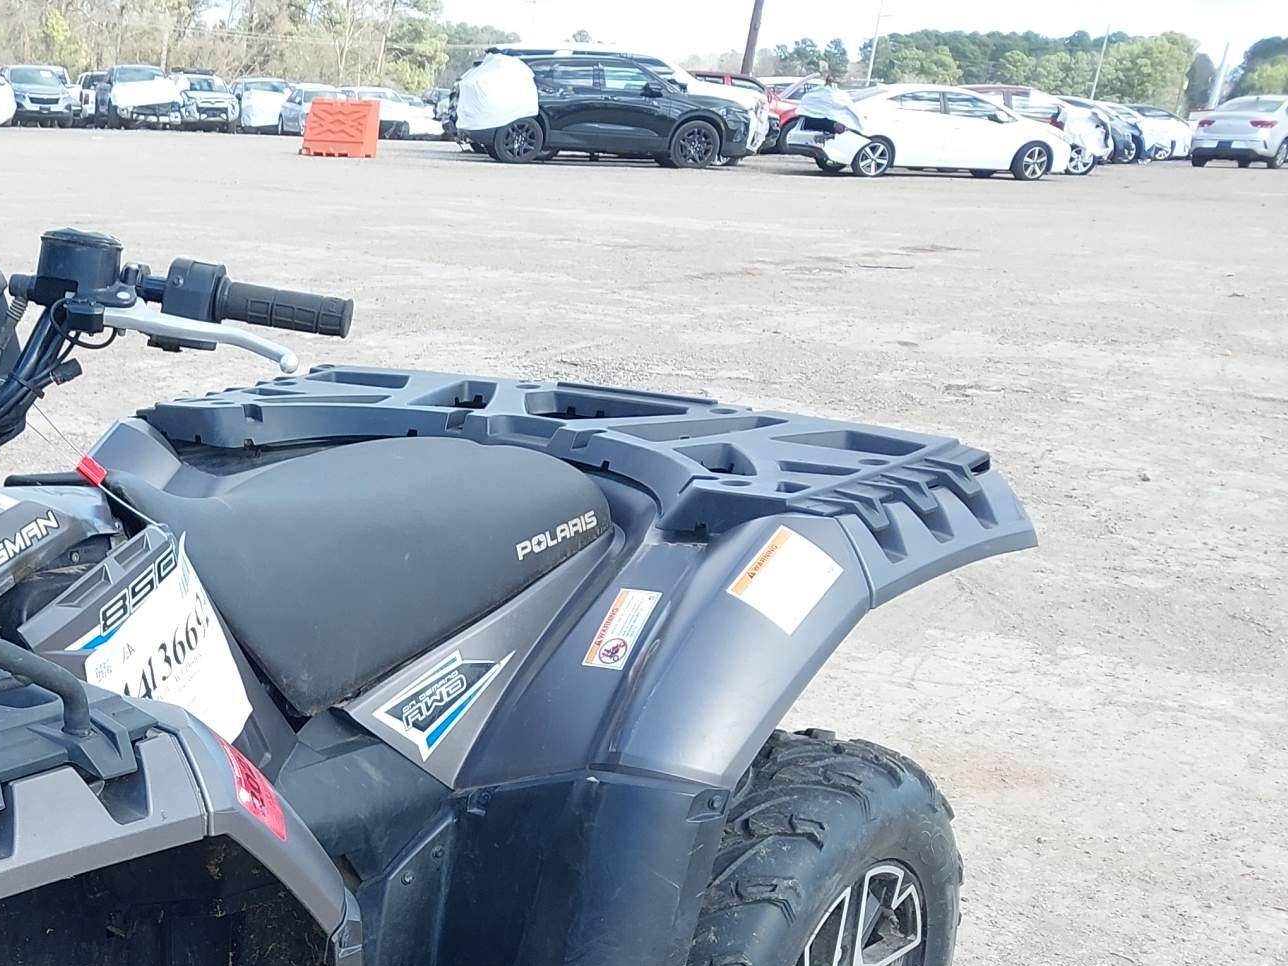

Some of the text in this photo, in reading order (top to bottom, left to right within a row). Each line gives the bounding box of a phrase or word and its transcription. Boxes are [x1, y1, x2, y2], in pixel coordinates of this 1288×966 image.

[515, 510, 598, 561] POLARIS
[752, 543, 779, 572] WARNING
[100, 545, 180, 637] 850
[403, 674, 467, 730] AWD
